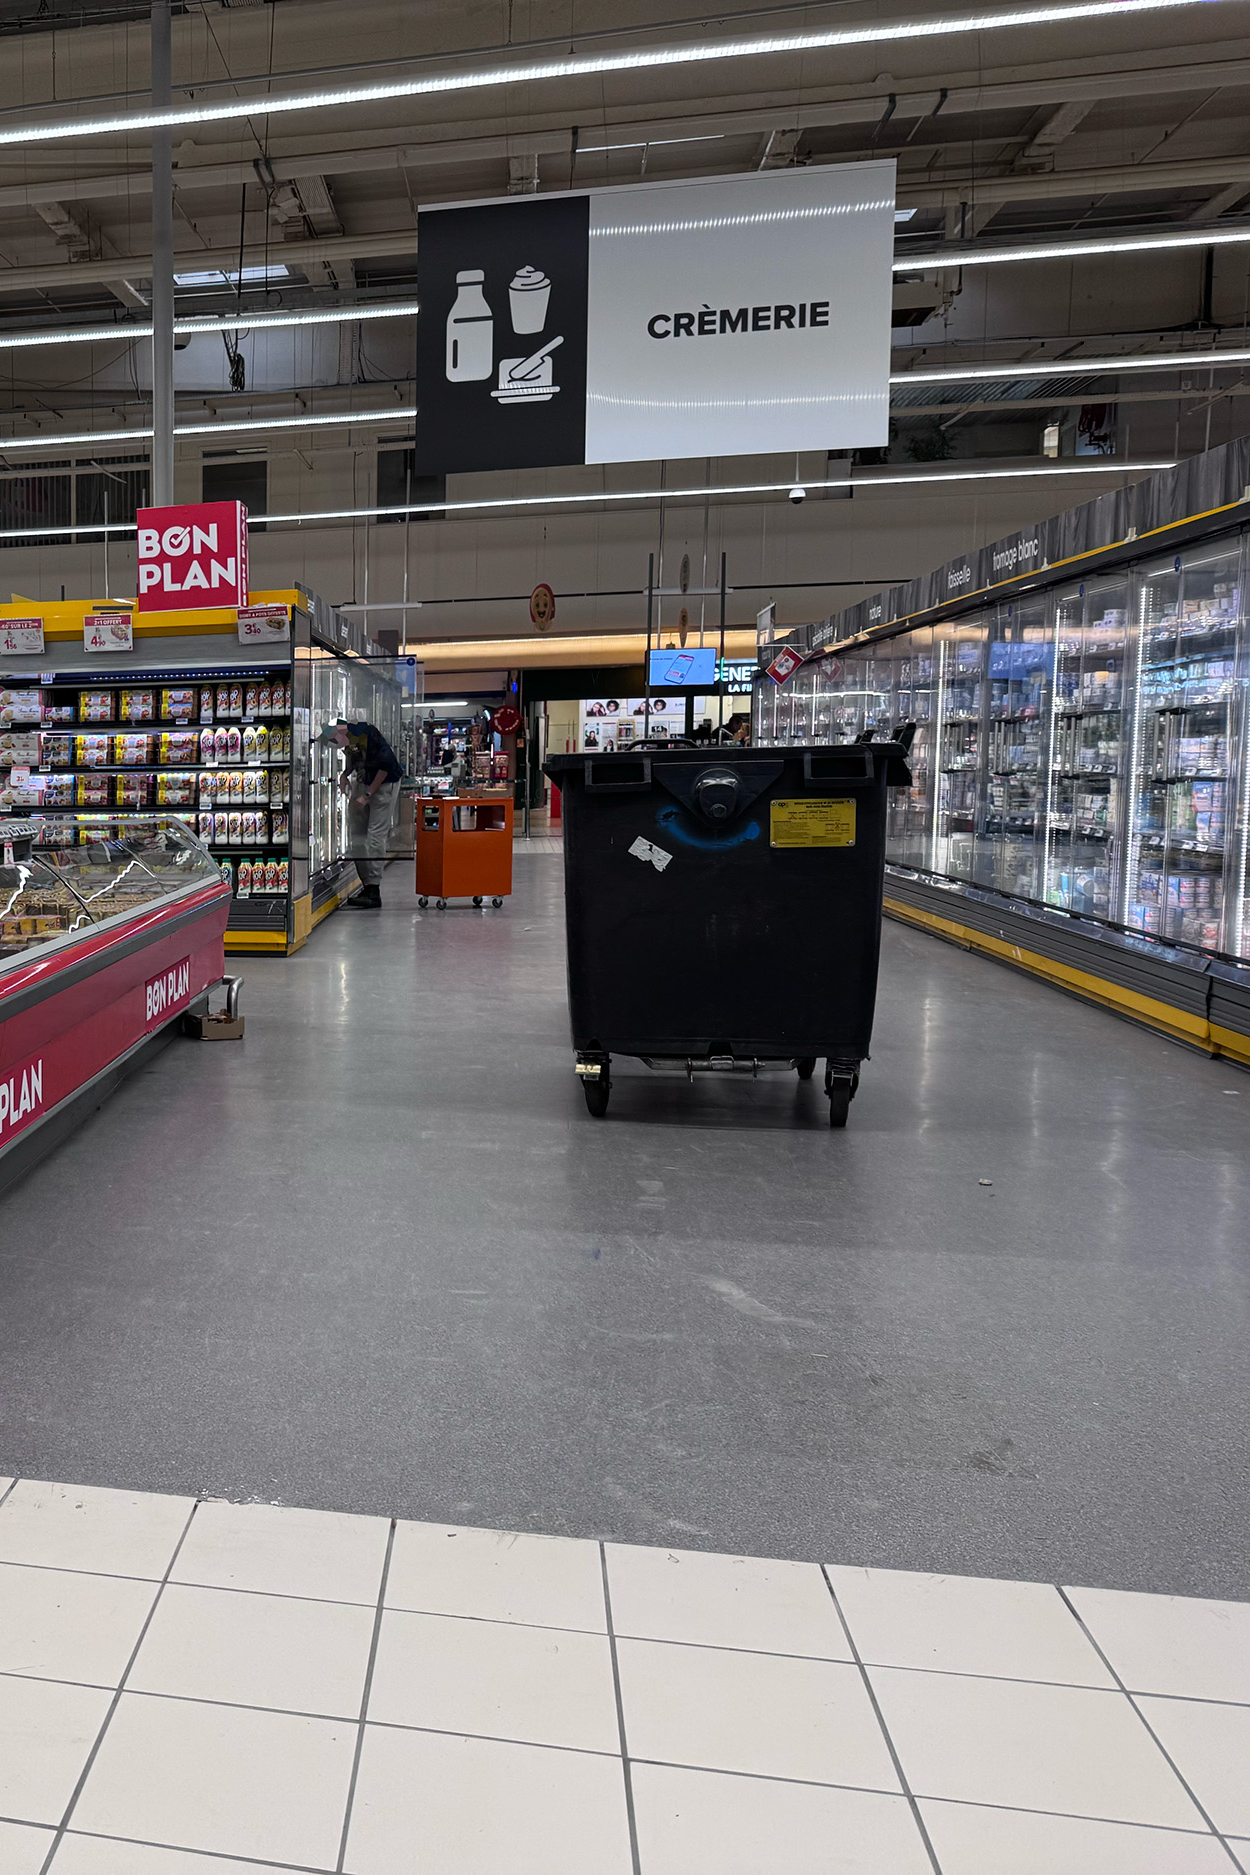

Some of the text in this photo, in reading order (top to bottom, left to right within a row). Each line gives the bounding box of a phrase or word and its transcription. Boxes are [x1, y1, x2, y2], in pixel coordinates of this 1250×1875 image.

[647, 301, 830, 340] CRÈMERIE
[138, 522, 218, 559] BON
[993, 538, 1039, 571] fromage blanc
[138, 557, 236, 594] PLAN
[728, 684, 741, 693] LA
[146, 961, 190, 1021] BON PLAN
